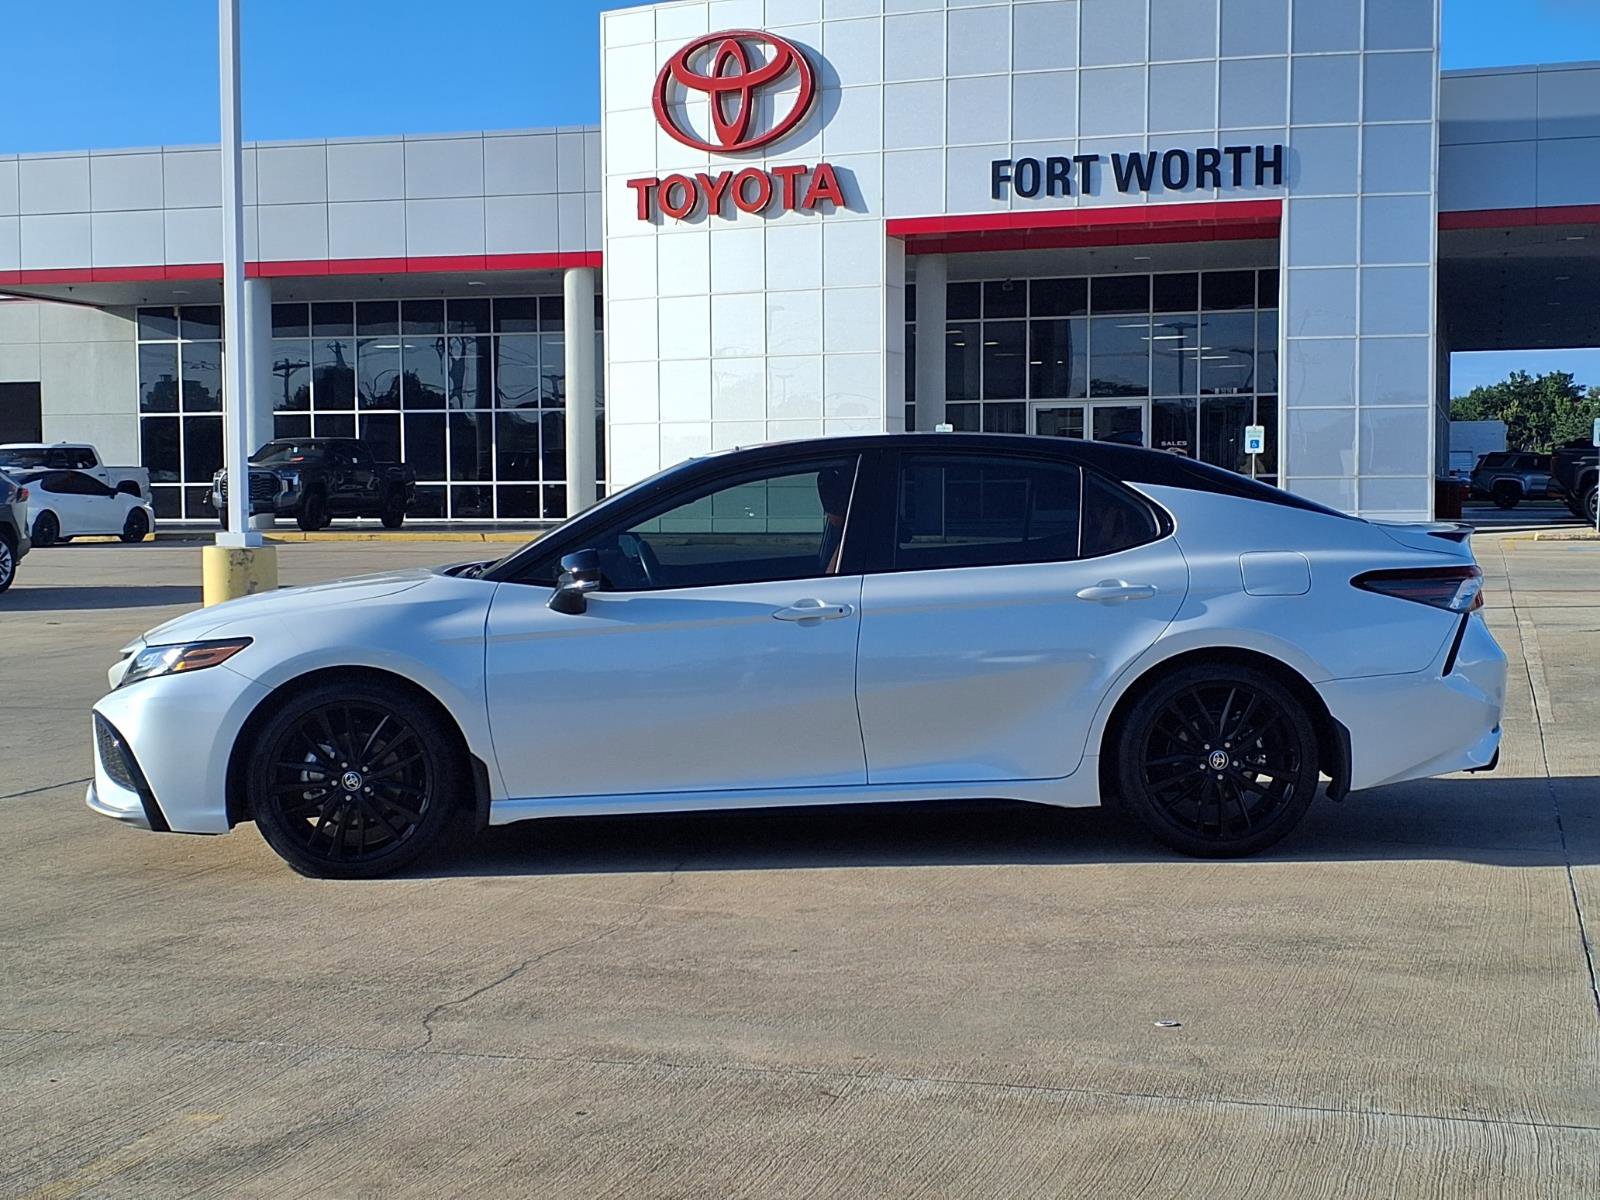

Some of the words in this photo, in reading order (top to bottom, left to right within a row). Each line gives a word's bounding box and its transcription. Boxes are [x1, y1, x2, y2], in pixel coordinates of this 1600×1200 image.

[627, 163, 846, 221] TOYOTA
[991, 154, 1099, 199] FORT
[1111, 145, 1282, 192] WORTH
